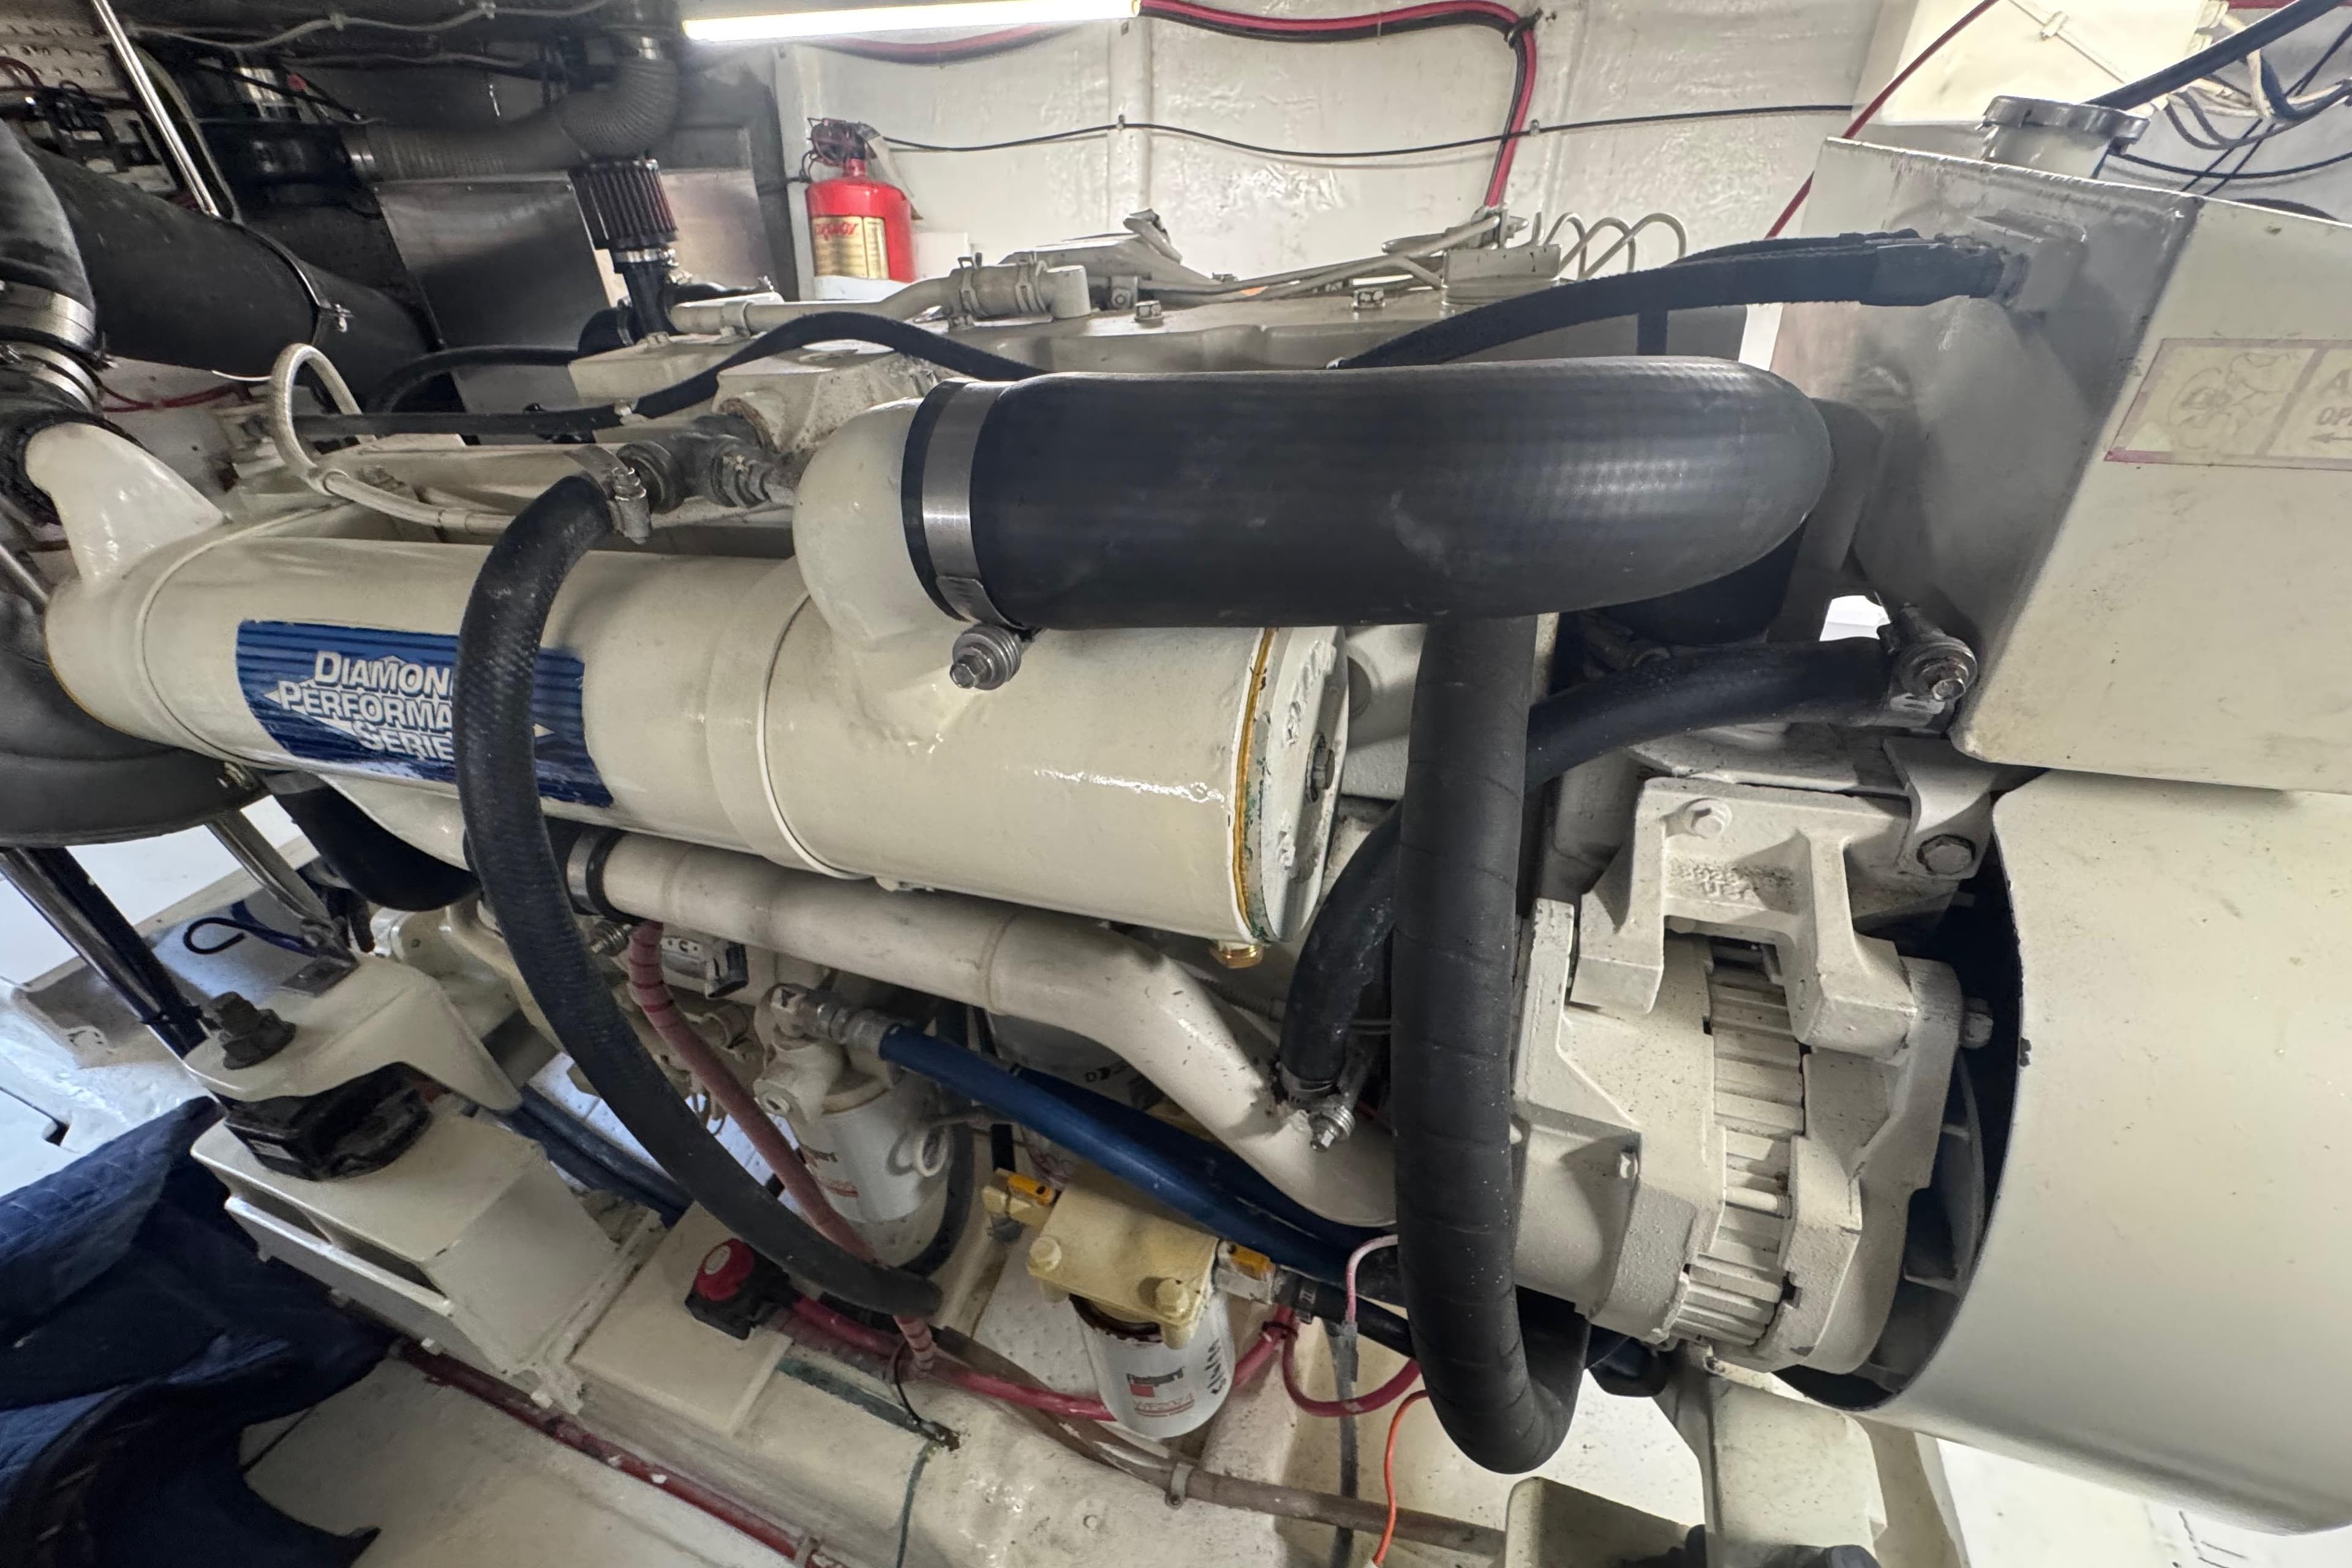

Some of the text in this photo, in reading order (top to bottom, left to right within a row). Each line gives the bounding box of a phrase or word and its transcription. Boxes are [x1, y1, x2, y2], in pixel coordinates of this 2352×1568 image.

[314, 650, 453, 696] DIAMON
[278, 680, 453, 731] PERFORMA
[352, 720, 455, 761] SERIE
